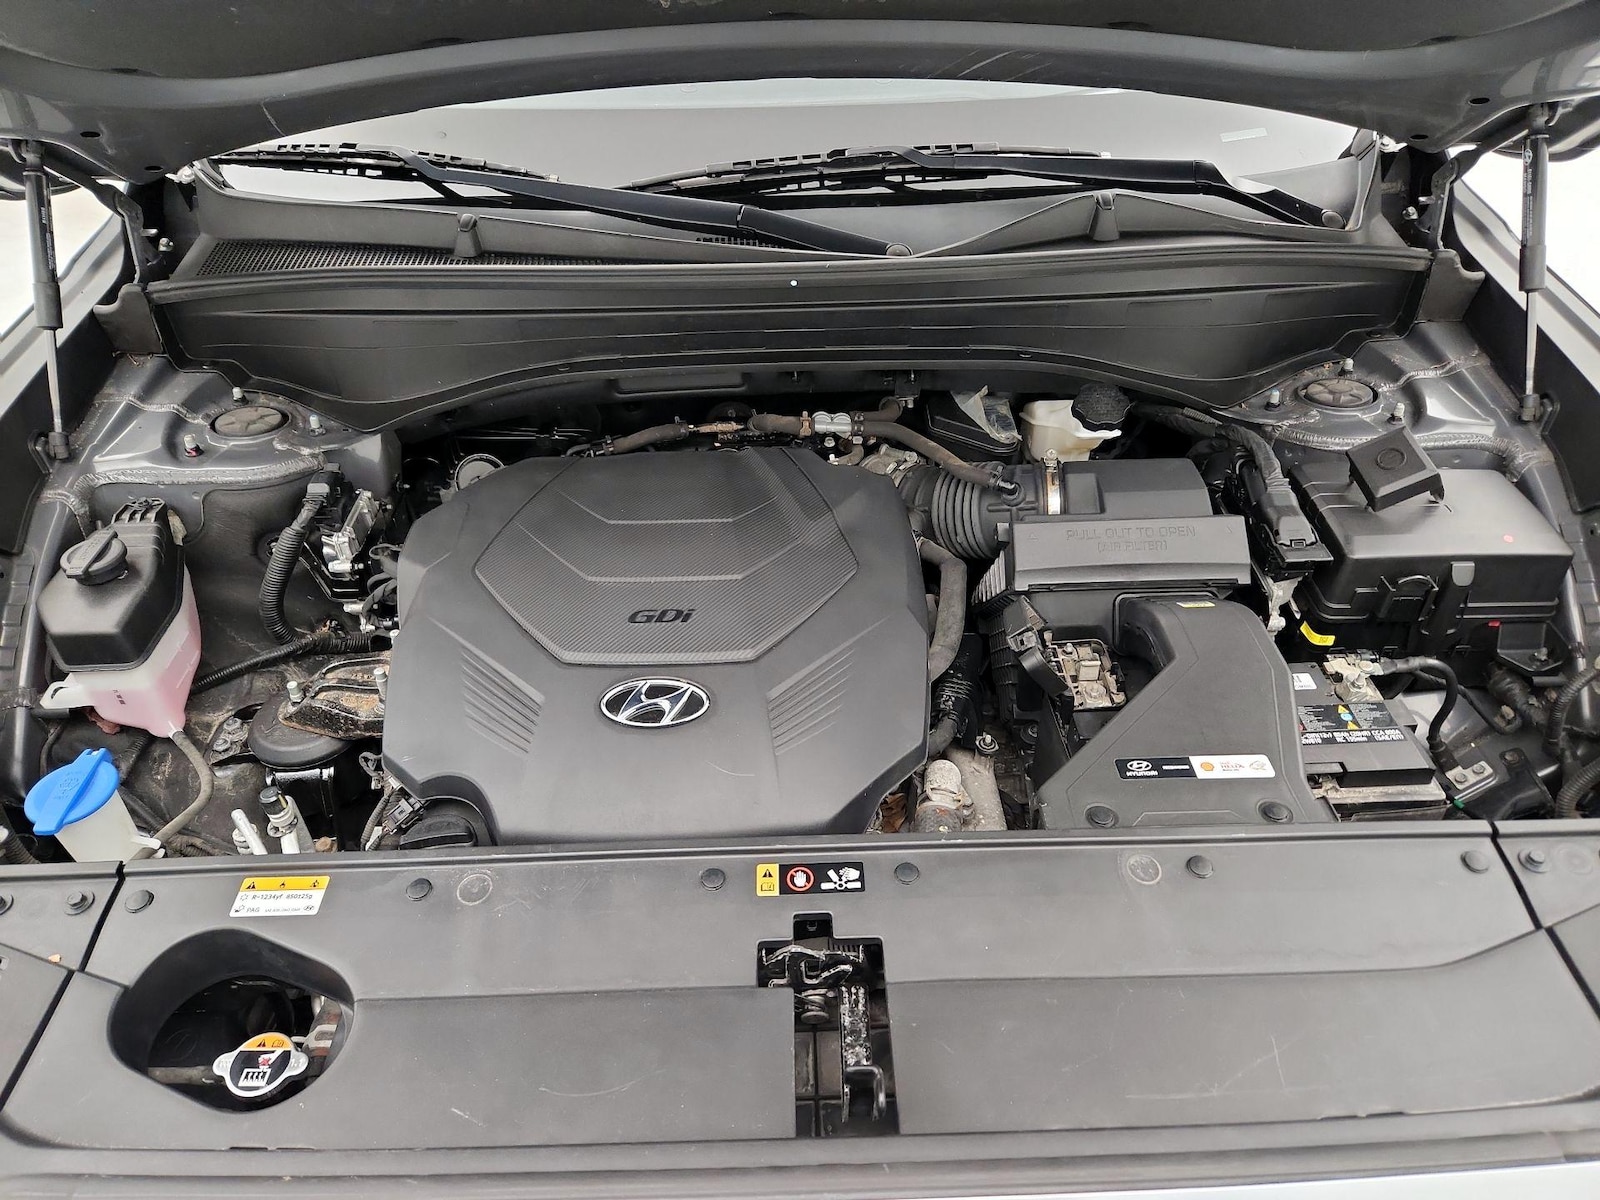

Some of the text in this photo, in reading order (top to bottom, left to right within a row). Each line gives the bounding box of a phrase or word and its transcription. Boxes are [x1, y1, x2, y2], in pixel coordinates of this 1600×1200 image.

[1066, 525, 1197, 540] PULL OUT TO OPEN
[628, 609, 695, 623] GDi
